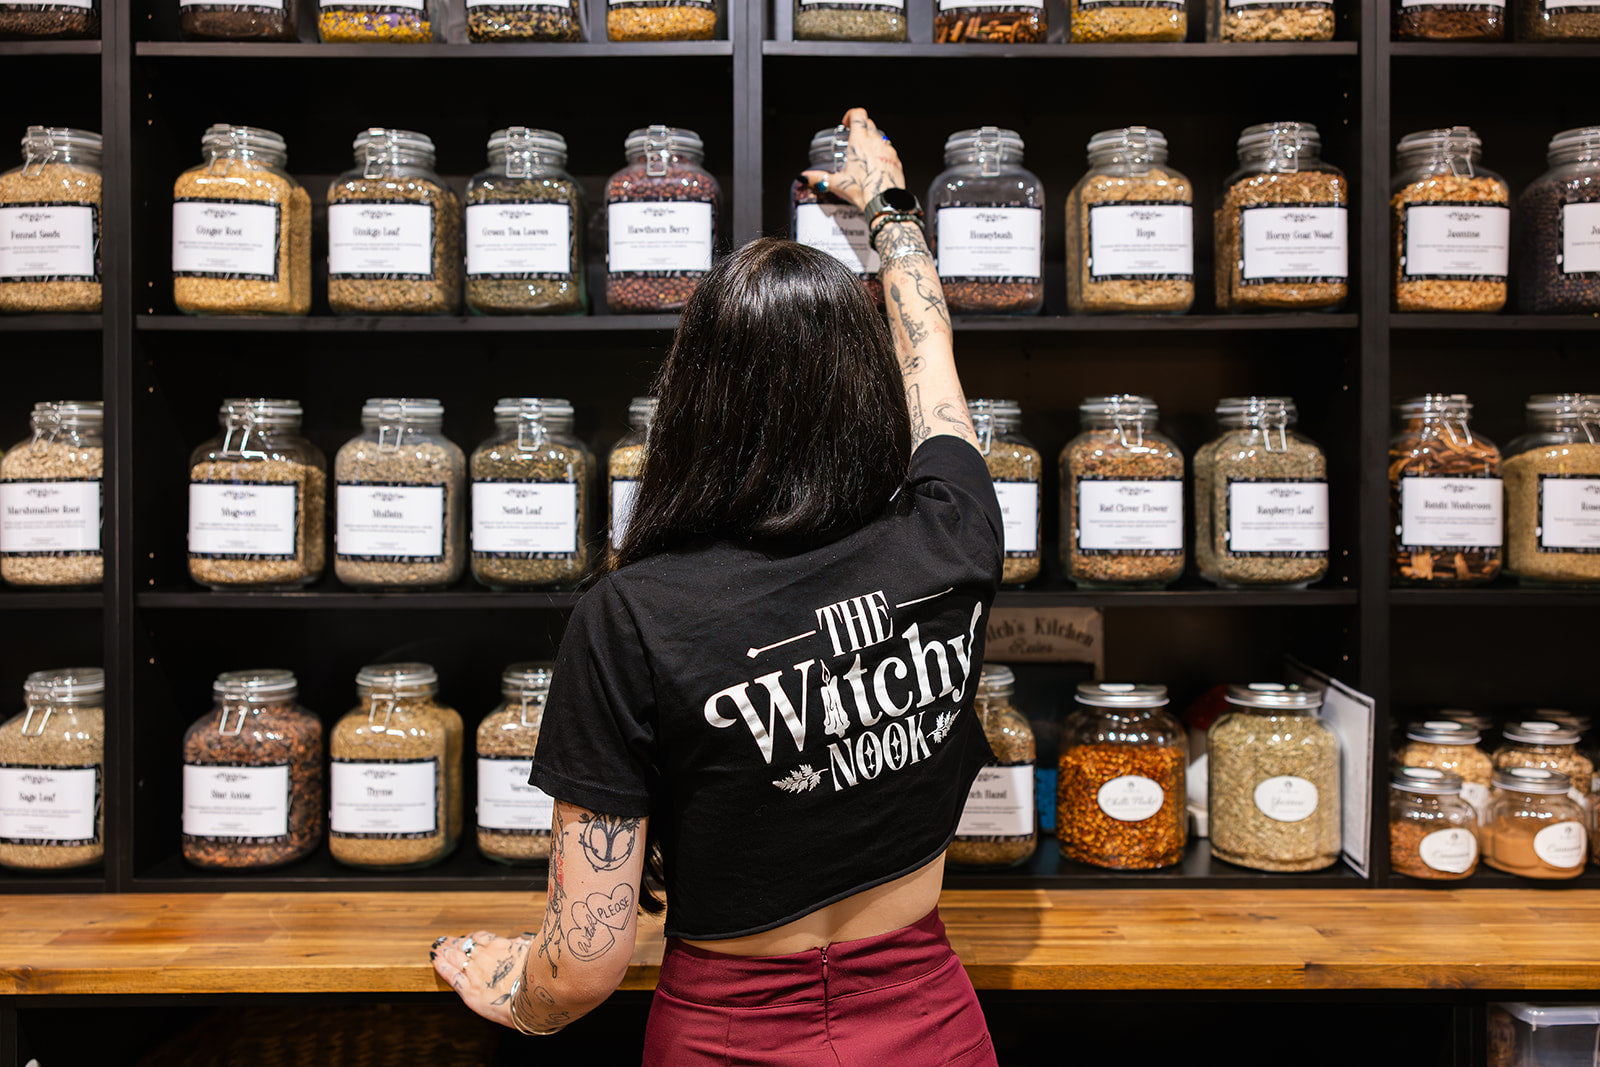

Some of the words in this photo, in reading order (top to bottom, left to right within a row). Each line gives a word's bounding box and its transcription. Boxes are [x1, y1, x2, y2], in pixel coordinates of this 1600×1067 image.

[10, 230, 37, 241] Fennel
[39, 229, 60, 240] Seeds
[196, 225, 222, 238] Ginger
[225, 226, 242, 236] Root
[383, 225, 400, 237] Leaf
[481, 227, 505, 237] Green
[508, 226, 521, 237] Tea
[523, 227, 549, 237] Leaves
[669, 224, 690, 236] Berry
[969, 229, 1013, 241] Honeybush
[1136, 228, 1157, 240] Hops
[1265, 231, 1291, 242] Horny
[1292, 230, 1312, 240] Goat
[1446, 229, 1481, 239] Jasmine
[7, 505, 60, 517] Marshmallow
[62, 504, 81, 515] Root
[221, 507, 256, 519] Mugwort
[525, 505, 543, 516] Leaf
[1100, 503, 1114, 513] Red
[1143, 503, 1169, 513] Flower
[1257, 505, 1295, 518] Raspberry
[1297, 505, 1315, 516] Leaf
[814, 589, 895, 659] THE
[986, 618, 1026, 643] itch's
[1034, 616, 1094, 649] Kitchen
[702, 600, 984, 766] Witchy
[826, 709, 935, 793] NOOK
[39, 792, 57, 803] Leaf
[367, 786, 394, 799] Thyme
